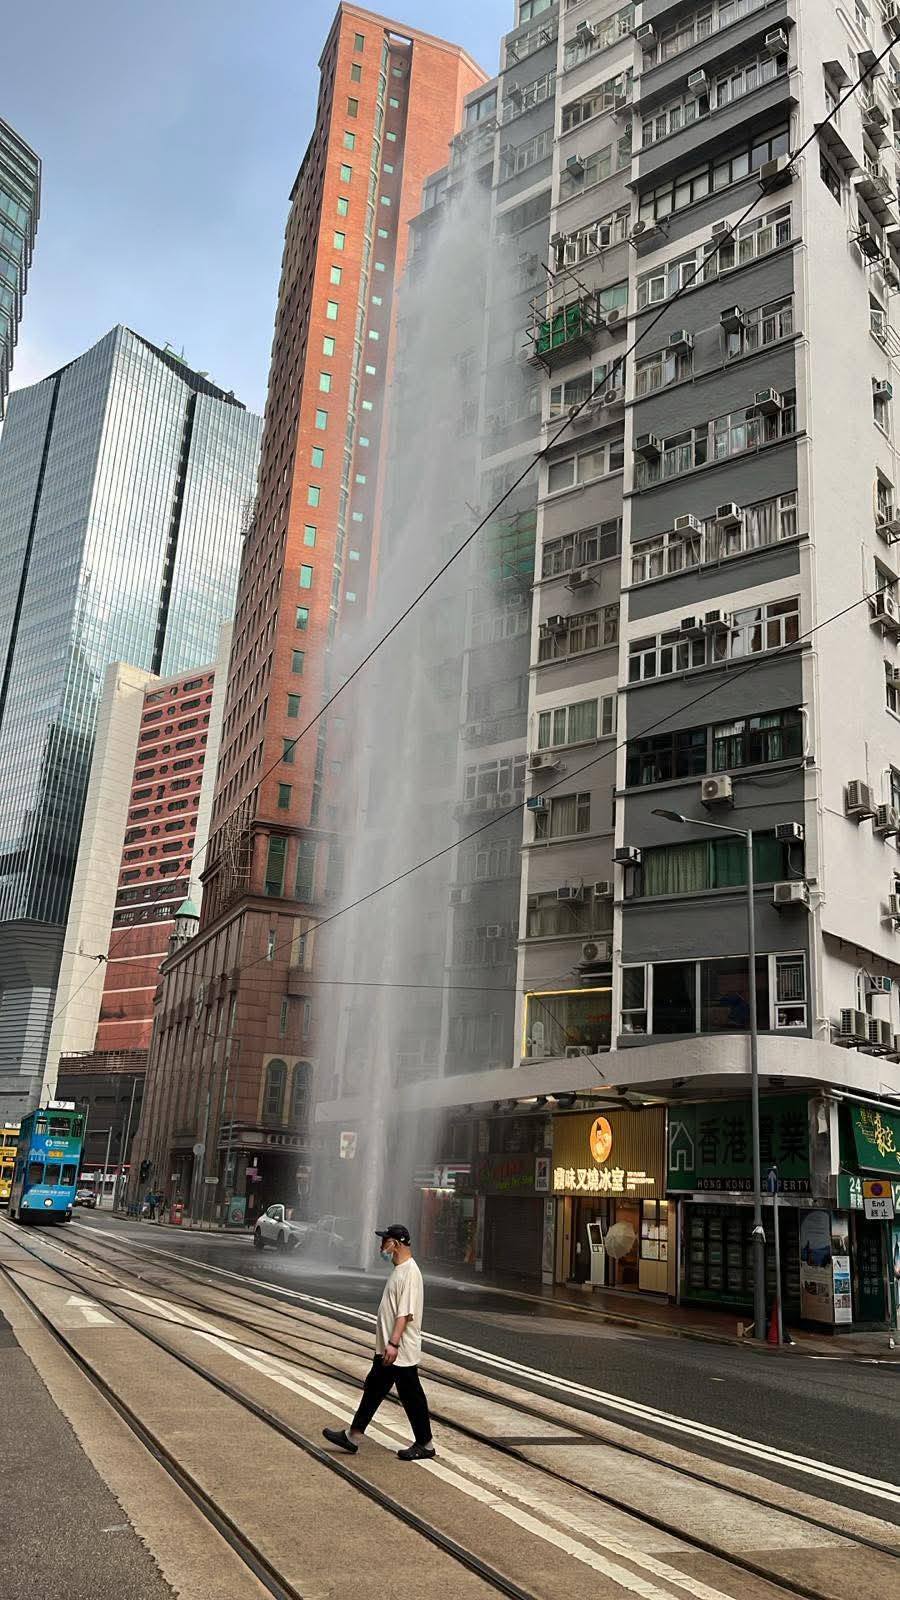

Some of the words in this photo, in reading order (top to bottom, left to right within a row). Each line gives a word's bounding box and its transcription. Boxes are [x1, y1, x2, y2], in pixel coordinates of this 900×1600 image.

[697, 1179, 722, 1191] HONG
[725, 1179, 752, 1191] KONG
[759, 1179, 809, 1192] RPERTY
